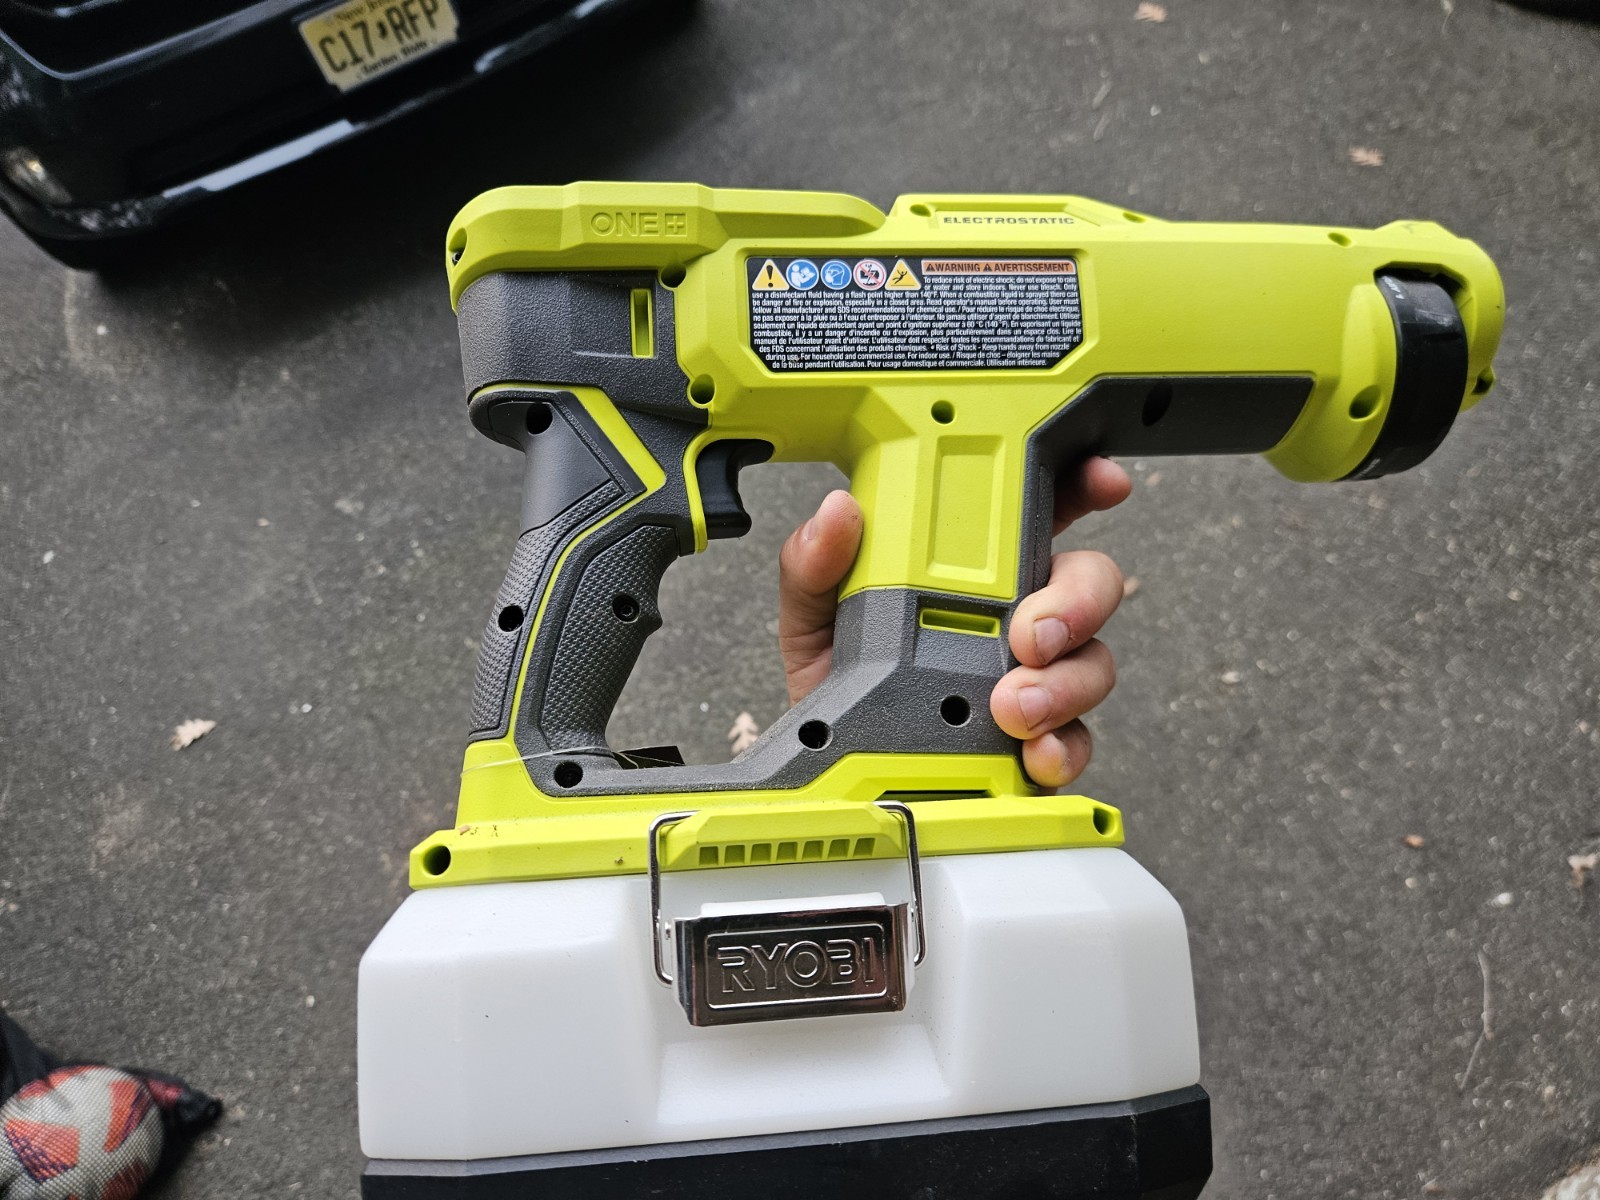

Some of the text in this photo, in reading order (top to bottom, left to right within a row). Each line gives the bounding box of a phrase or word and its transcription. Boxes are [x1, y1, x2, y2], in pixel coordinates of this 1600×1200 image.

[318, 20, 375, 73] C17
[943, 217, 1075, 225] ELECTROSTATIC
[934, 262, 1070, 273] WARNING AVERTISSEMENT
[953, 276, 964, 284] risk
[932, 283, 950, 291] water
[952, 283, 964, 291] and
[966, 283, 981, 291] store
[1063, 283, 1077, 292] Only
[867, 291, 882, 299] point
[884, 291, 903, 299] higher
[940, 290, 956, 298] When
[1050, 290, 1065, 298] there
[792, 298, 803, 306] fire
[889, 298, 908, 306] closed
[926, 298, 942, 306] Read
[752, 306, 771, 314] follow
[961, 305, 975, 313] Pour
[1005, 305, 1023, 314] risque
[762, 315, 773, 323] pas
[813, 314, 828, 322] pluie
[843, 313, 858, 321] l'eau
[858, 321, 874, 330] ayant
[885, 321, 901, 330] point
[930, 328, 943, 337] plus
[1062, 327, 1074, 335] Lire
[824, 336, 841, 344] avant
[856, 344, 867, 352] des
[982, 343, 997, 352] Keep
[998, 343, 1016, 351] hands
[1018, 344, 1033, 352] away
[800, 352, 810, 360] For
[844, 352, 856, 360] and
[788, 360, 803, 368] buse
[717, 937, 876, 993] RYOBI
